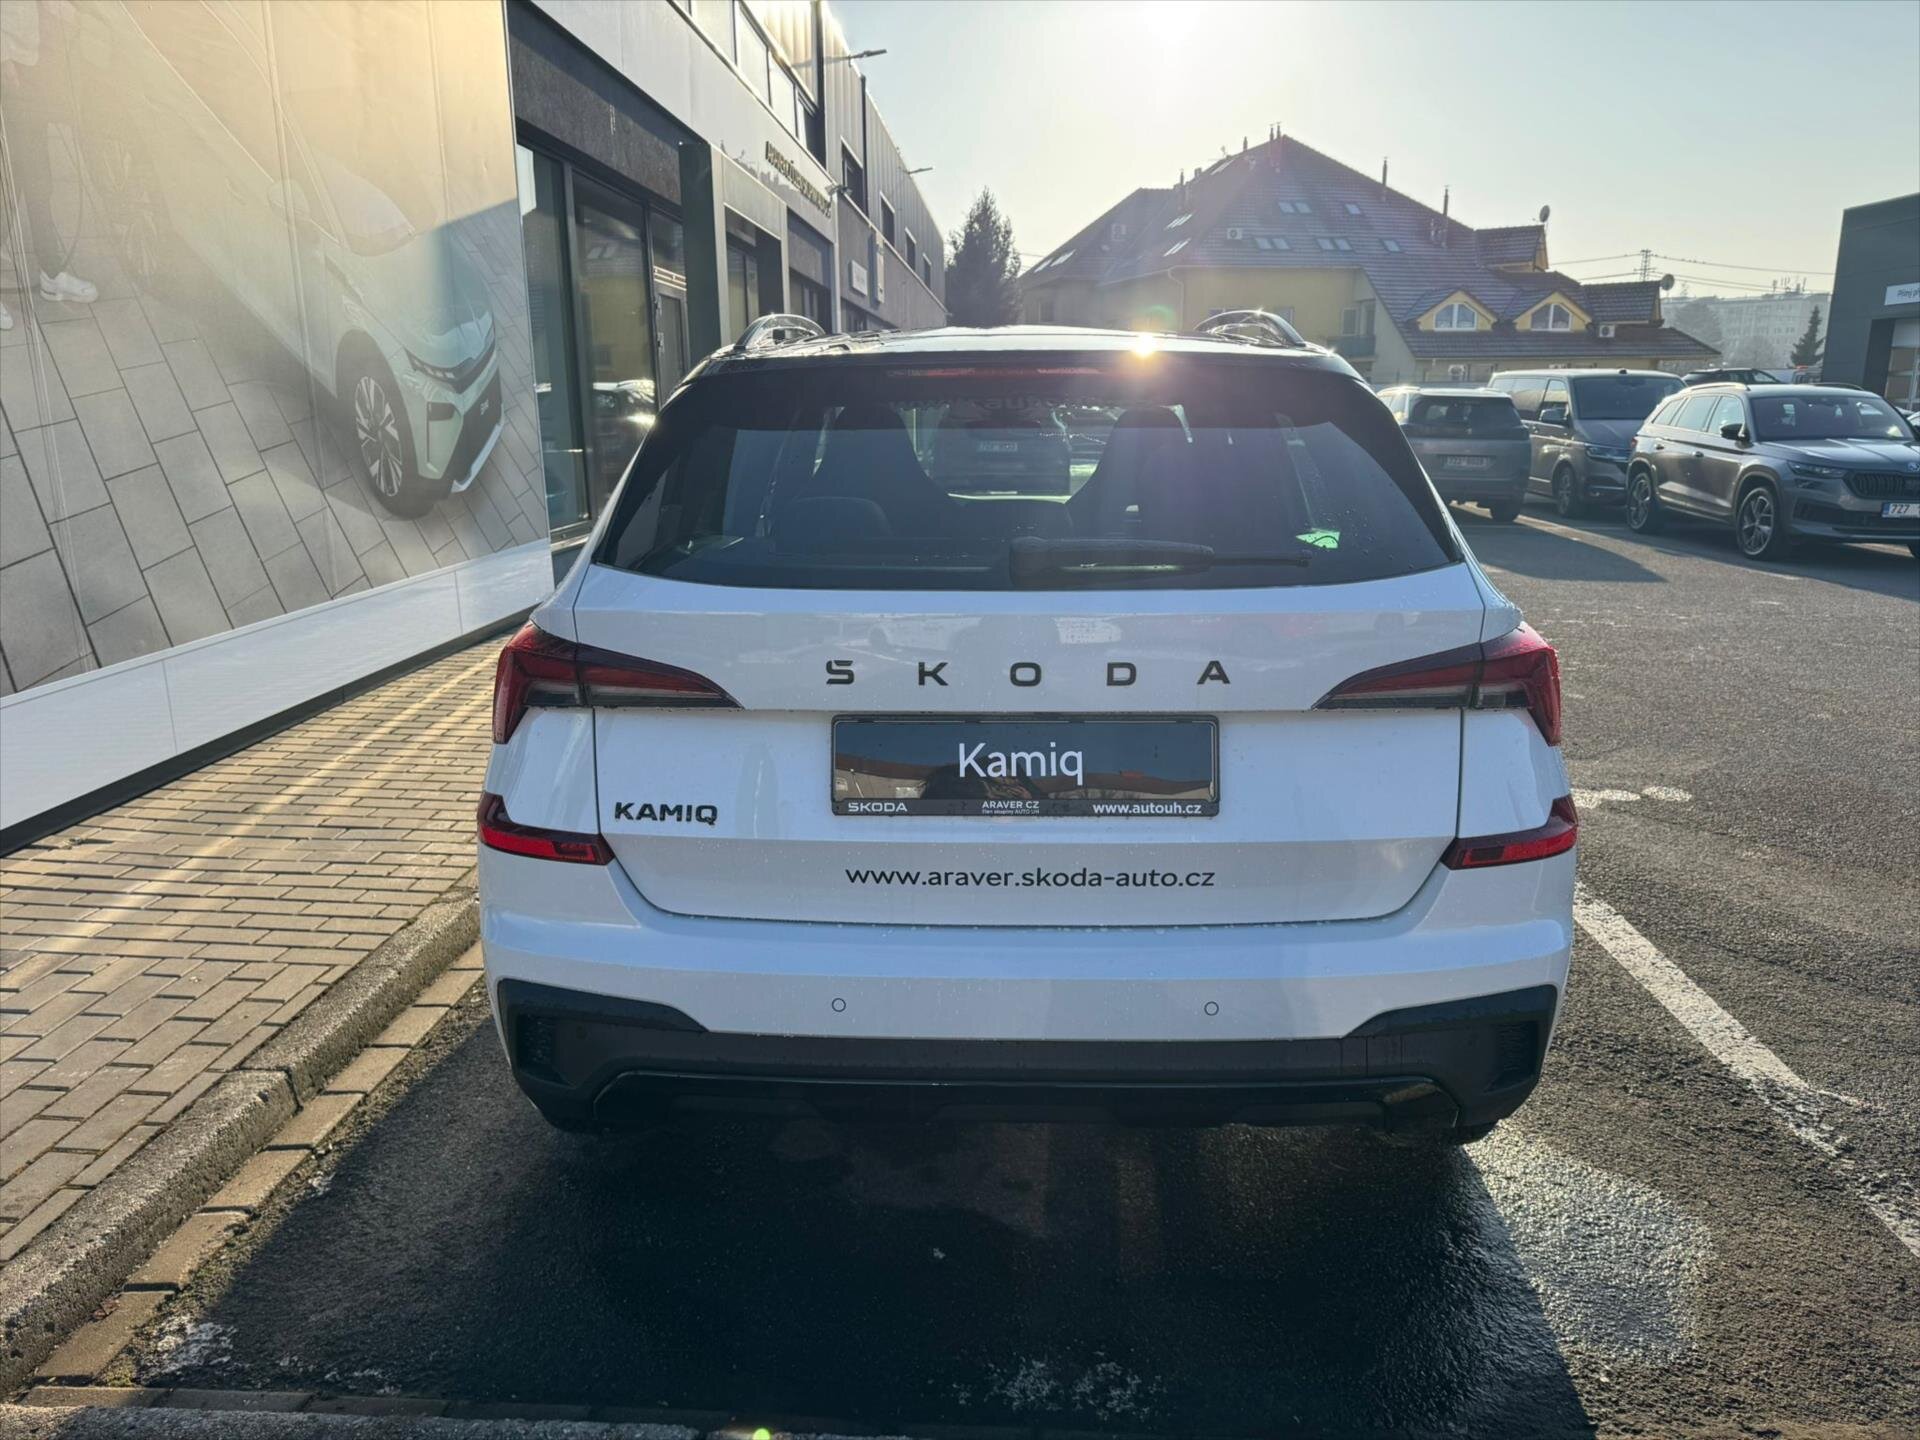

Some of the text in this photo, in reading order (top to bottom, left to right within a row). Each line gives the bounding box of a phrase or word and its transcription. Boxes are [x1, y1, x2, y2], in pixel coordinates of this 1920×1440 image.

[958, 741, 1084, 786] Kamiq
[614, 801, 718, 826] KAMIQ
[981, 800, 1040, 809] ARAVER CZ
[1092, 801, 1202, 814] www.autouh.cz
[845, 867, 1216, 887] www.araver.skoda-auto.cz
